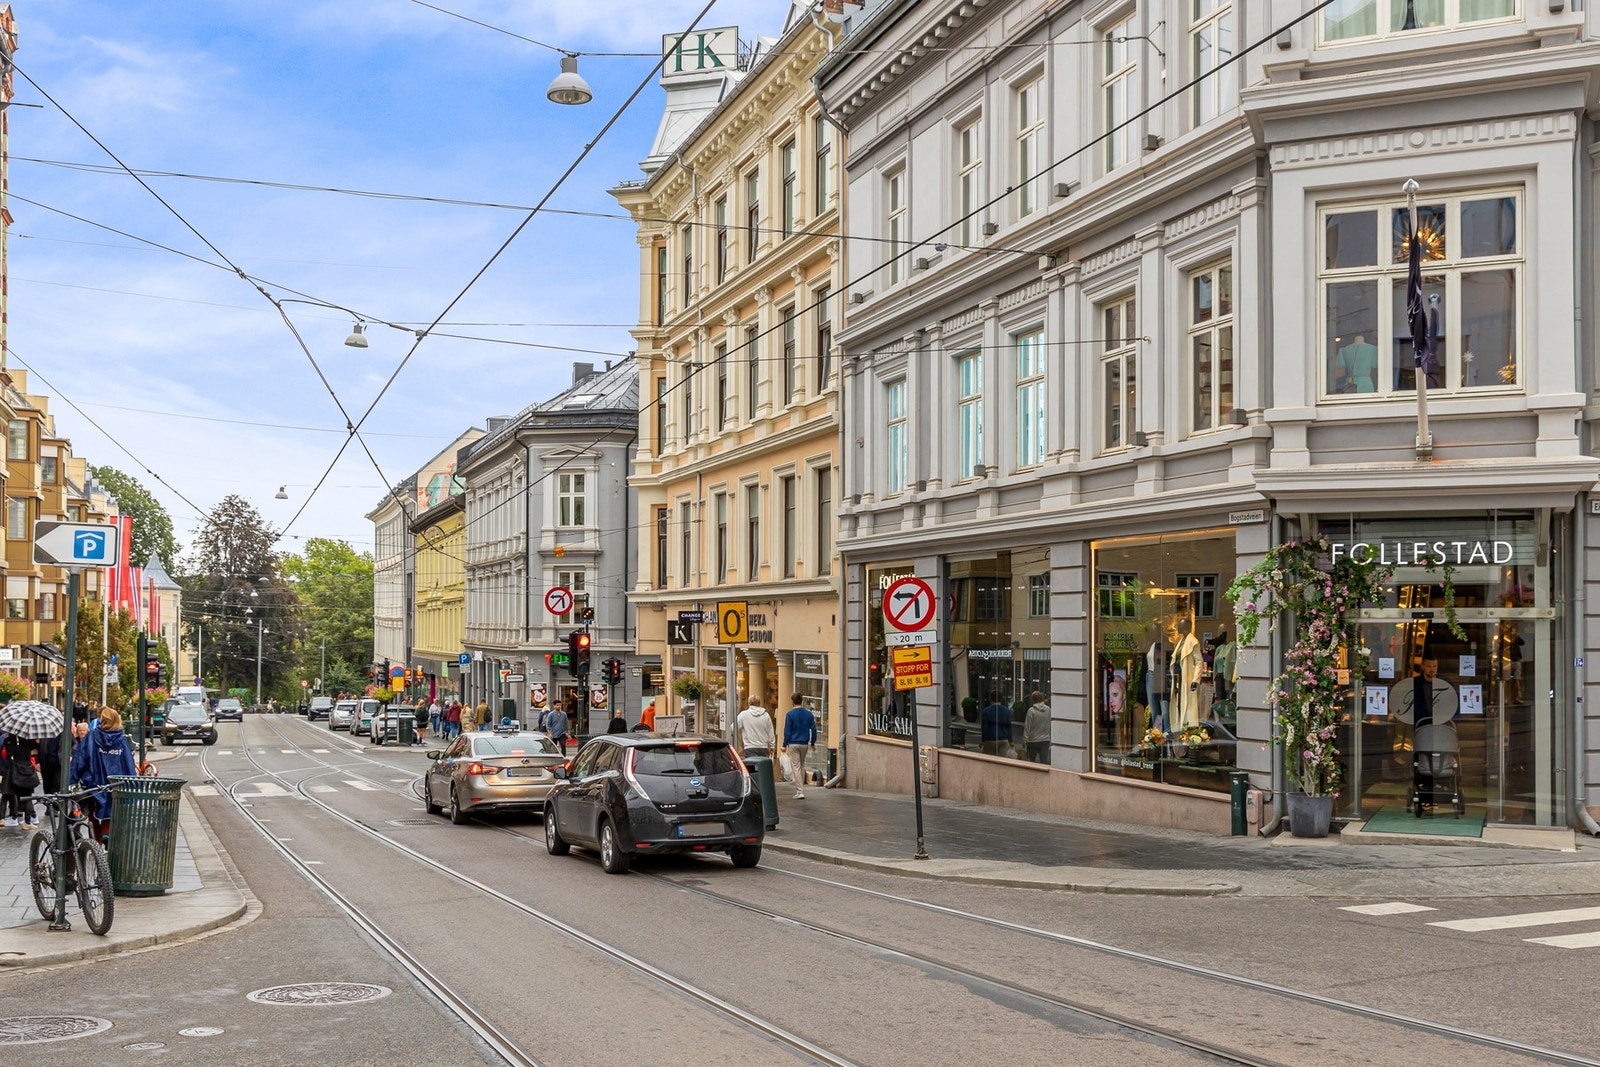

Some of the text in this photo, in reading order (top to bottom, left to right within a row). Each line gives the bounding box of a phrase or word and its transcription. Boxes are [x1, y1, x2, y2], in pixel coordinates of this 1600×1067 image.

[673, 31, 726, 72] HK
[1231, 513, 1262, 522] Bogstadveien
[1331, 541, 1513, 566] FOLLESTAD
[900, 635, 910, 643] 20
[896, 665, 915, 673] STOPP
